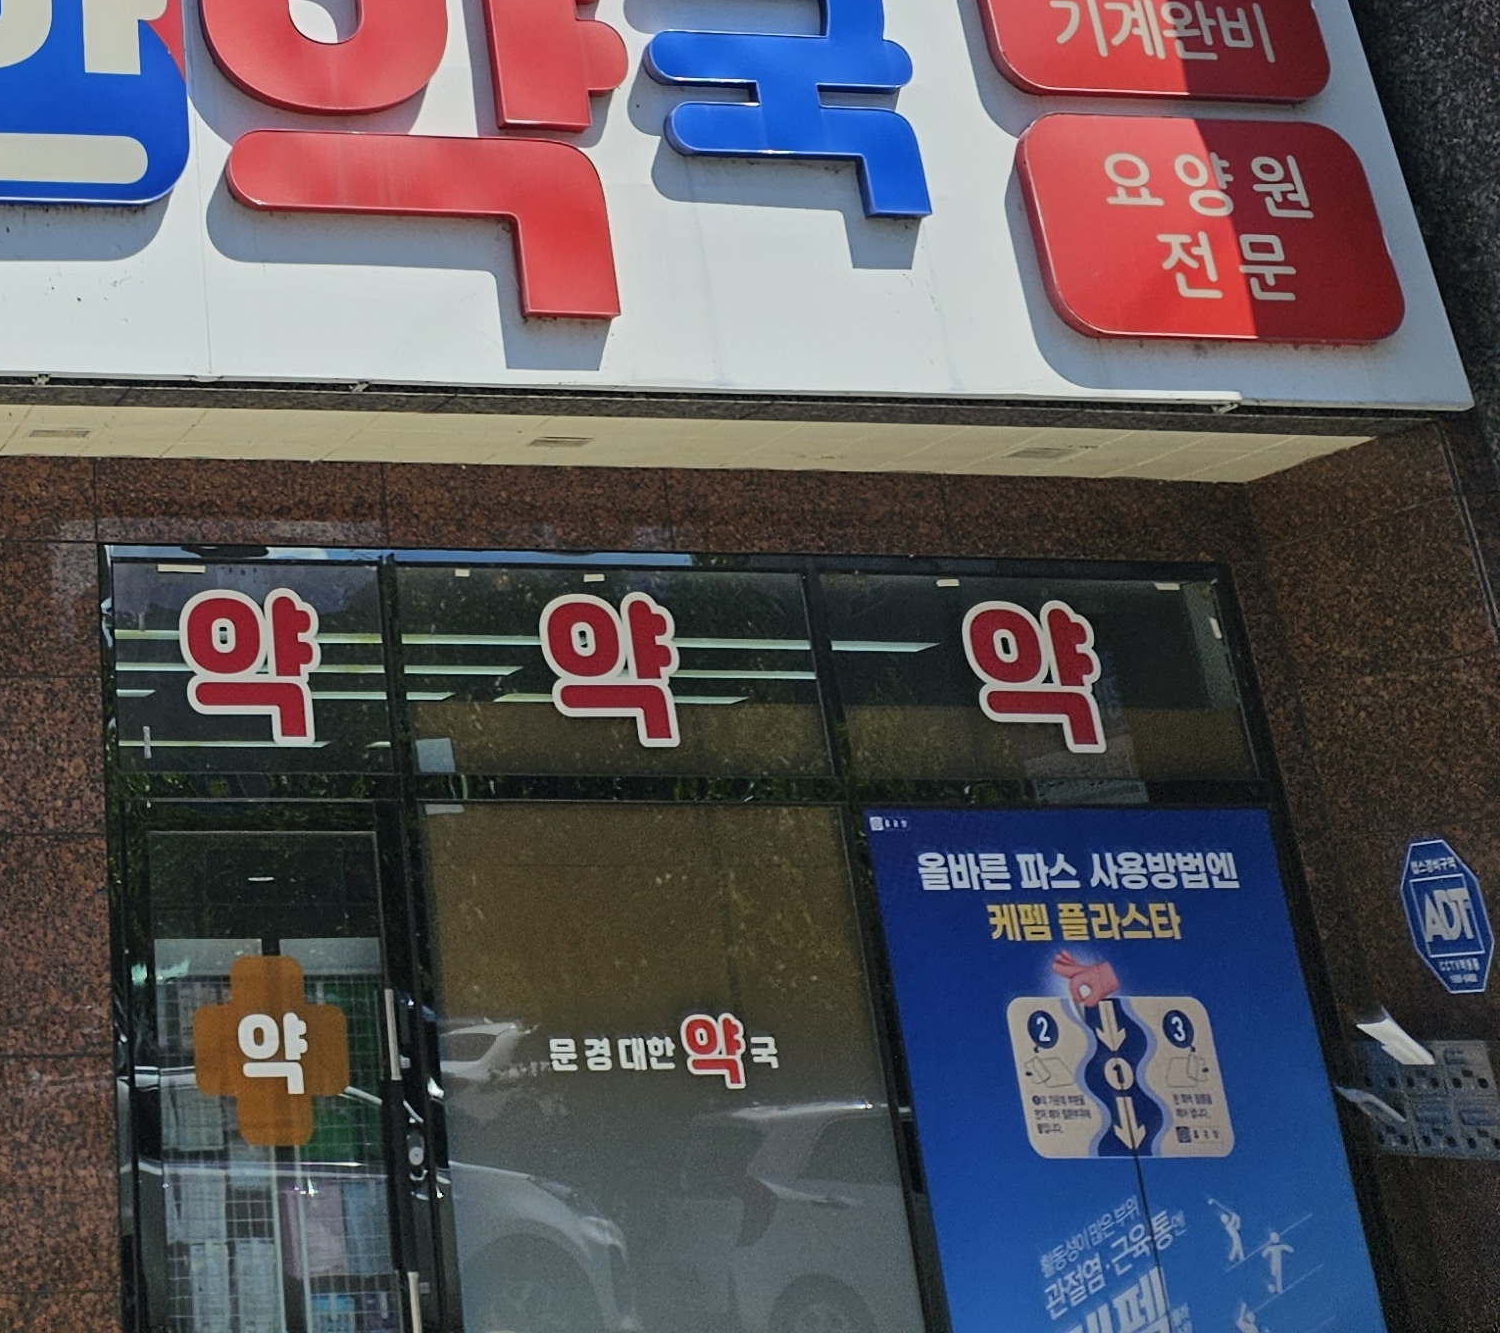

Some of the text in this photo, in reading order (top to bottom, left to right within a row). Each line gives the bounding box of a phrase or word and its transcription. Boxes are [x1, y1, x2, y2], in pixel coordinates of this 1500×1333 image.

[178, 587, 322, 746] 약
[539, 591, 680, 748] 약
[962, 600, 1107, 754] 약
[918, 851, 1240, 891] 올바른 파스 사용방법엔
[1057, 902, 1182, 941] 플라스타
[1424, 887, 1475, 943] ADT
[237, 1012, 308, 1096] 약
[1036, 1016, 1051, 1041] 2
[1171, 1016, 1186, 1041] 3
